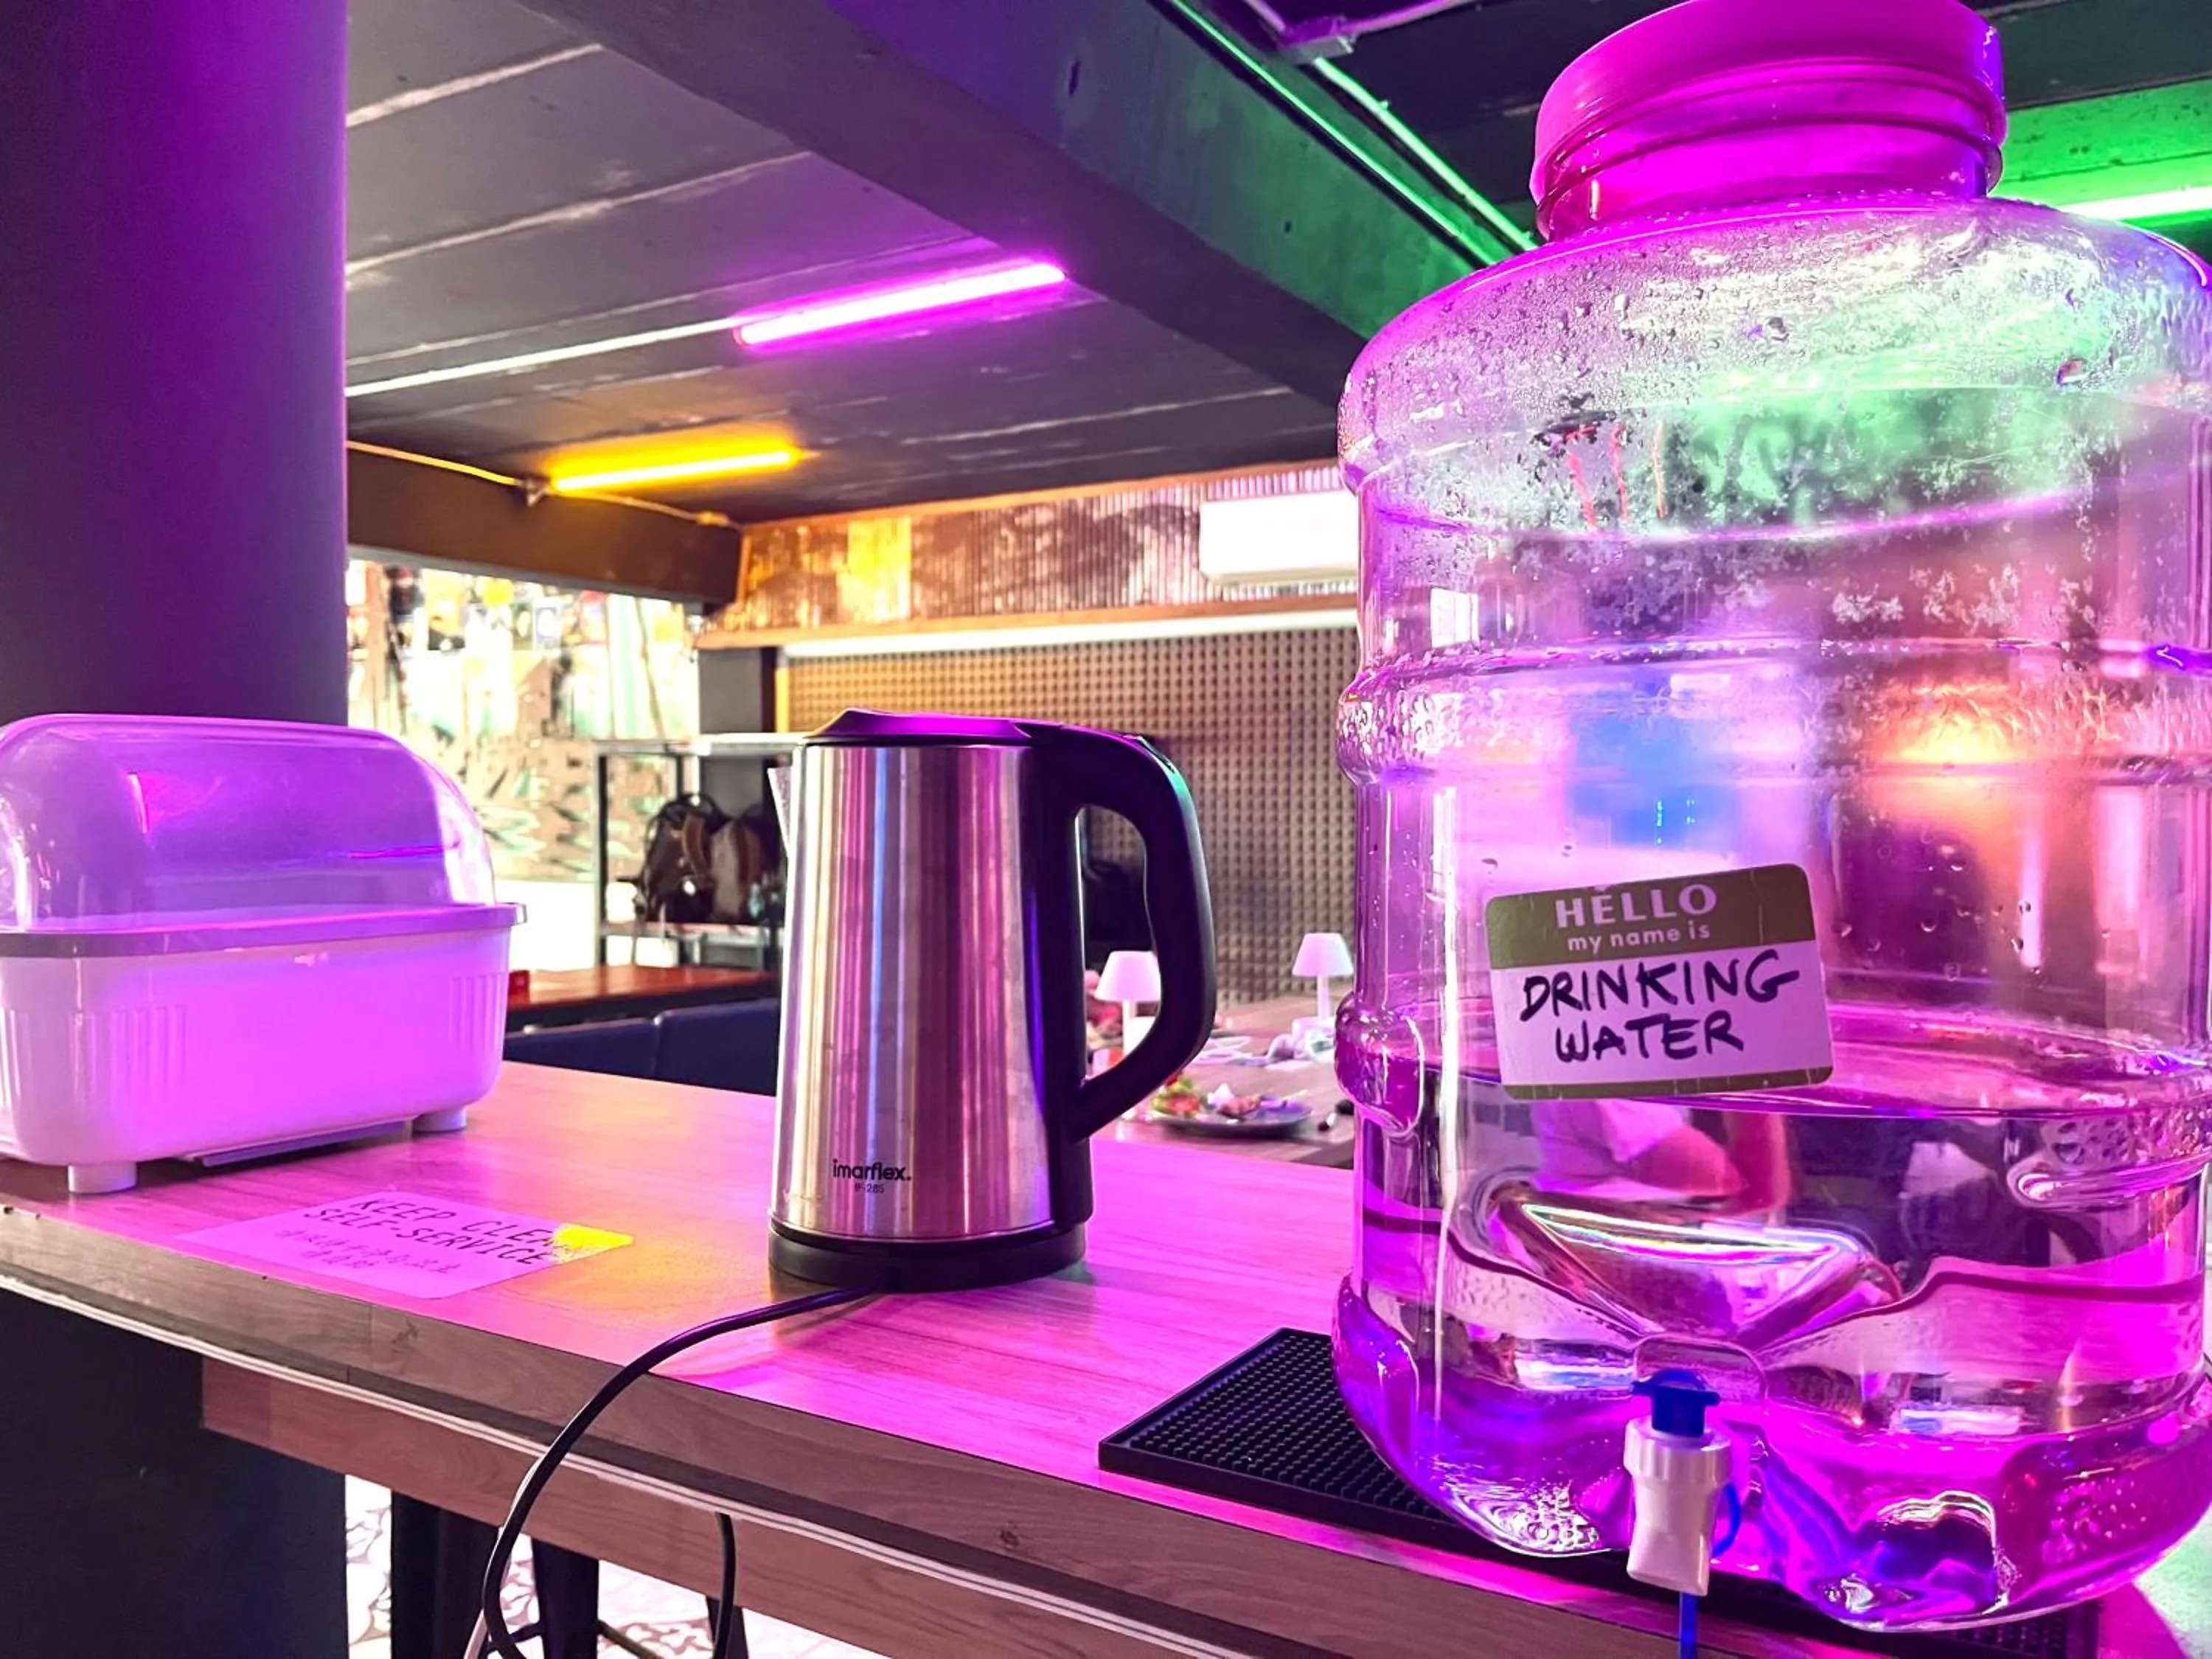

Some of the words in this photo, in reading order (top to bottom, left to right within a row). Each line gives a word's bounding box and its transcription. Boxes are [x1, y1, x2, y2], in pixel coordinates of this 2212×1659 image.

[1556, 884, 1717, 928] HELLO
[1568, 936, 1602, 953] my
[1610, 927, 1681, 947] name
[1688, 919, 1711, 940] is
[1520, 949, 1800, 1022] DRINKING
[1555, 1010, 1744, 1063] WATER
[349, 1199, 456, 1221] KEEP
[303, 1208, 553, 1265] SELF-SERVICE
